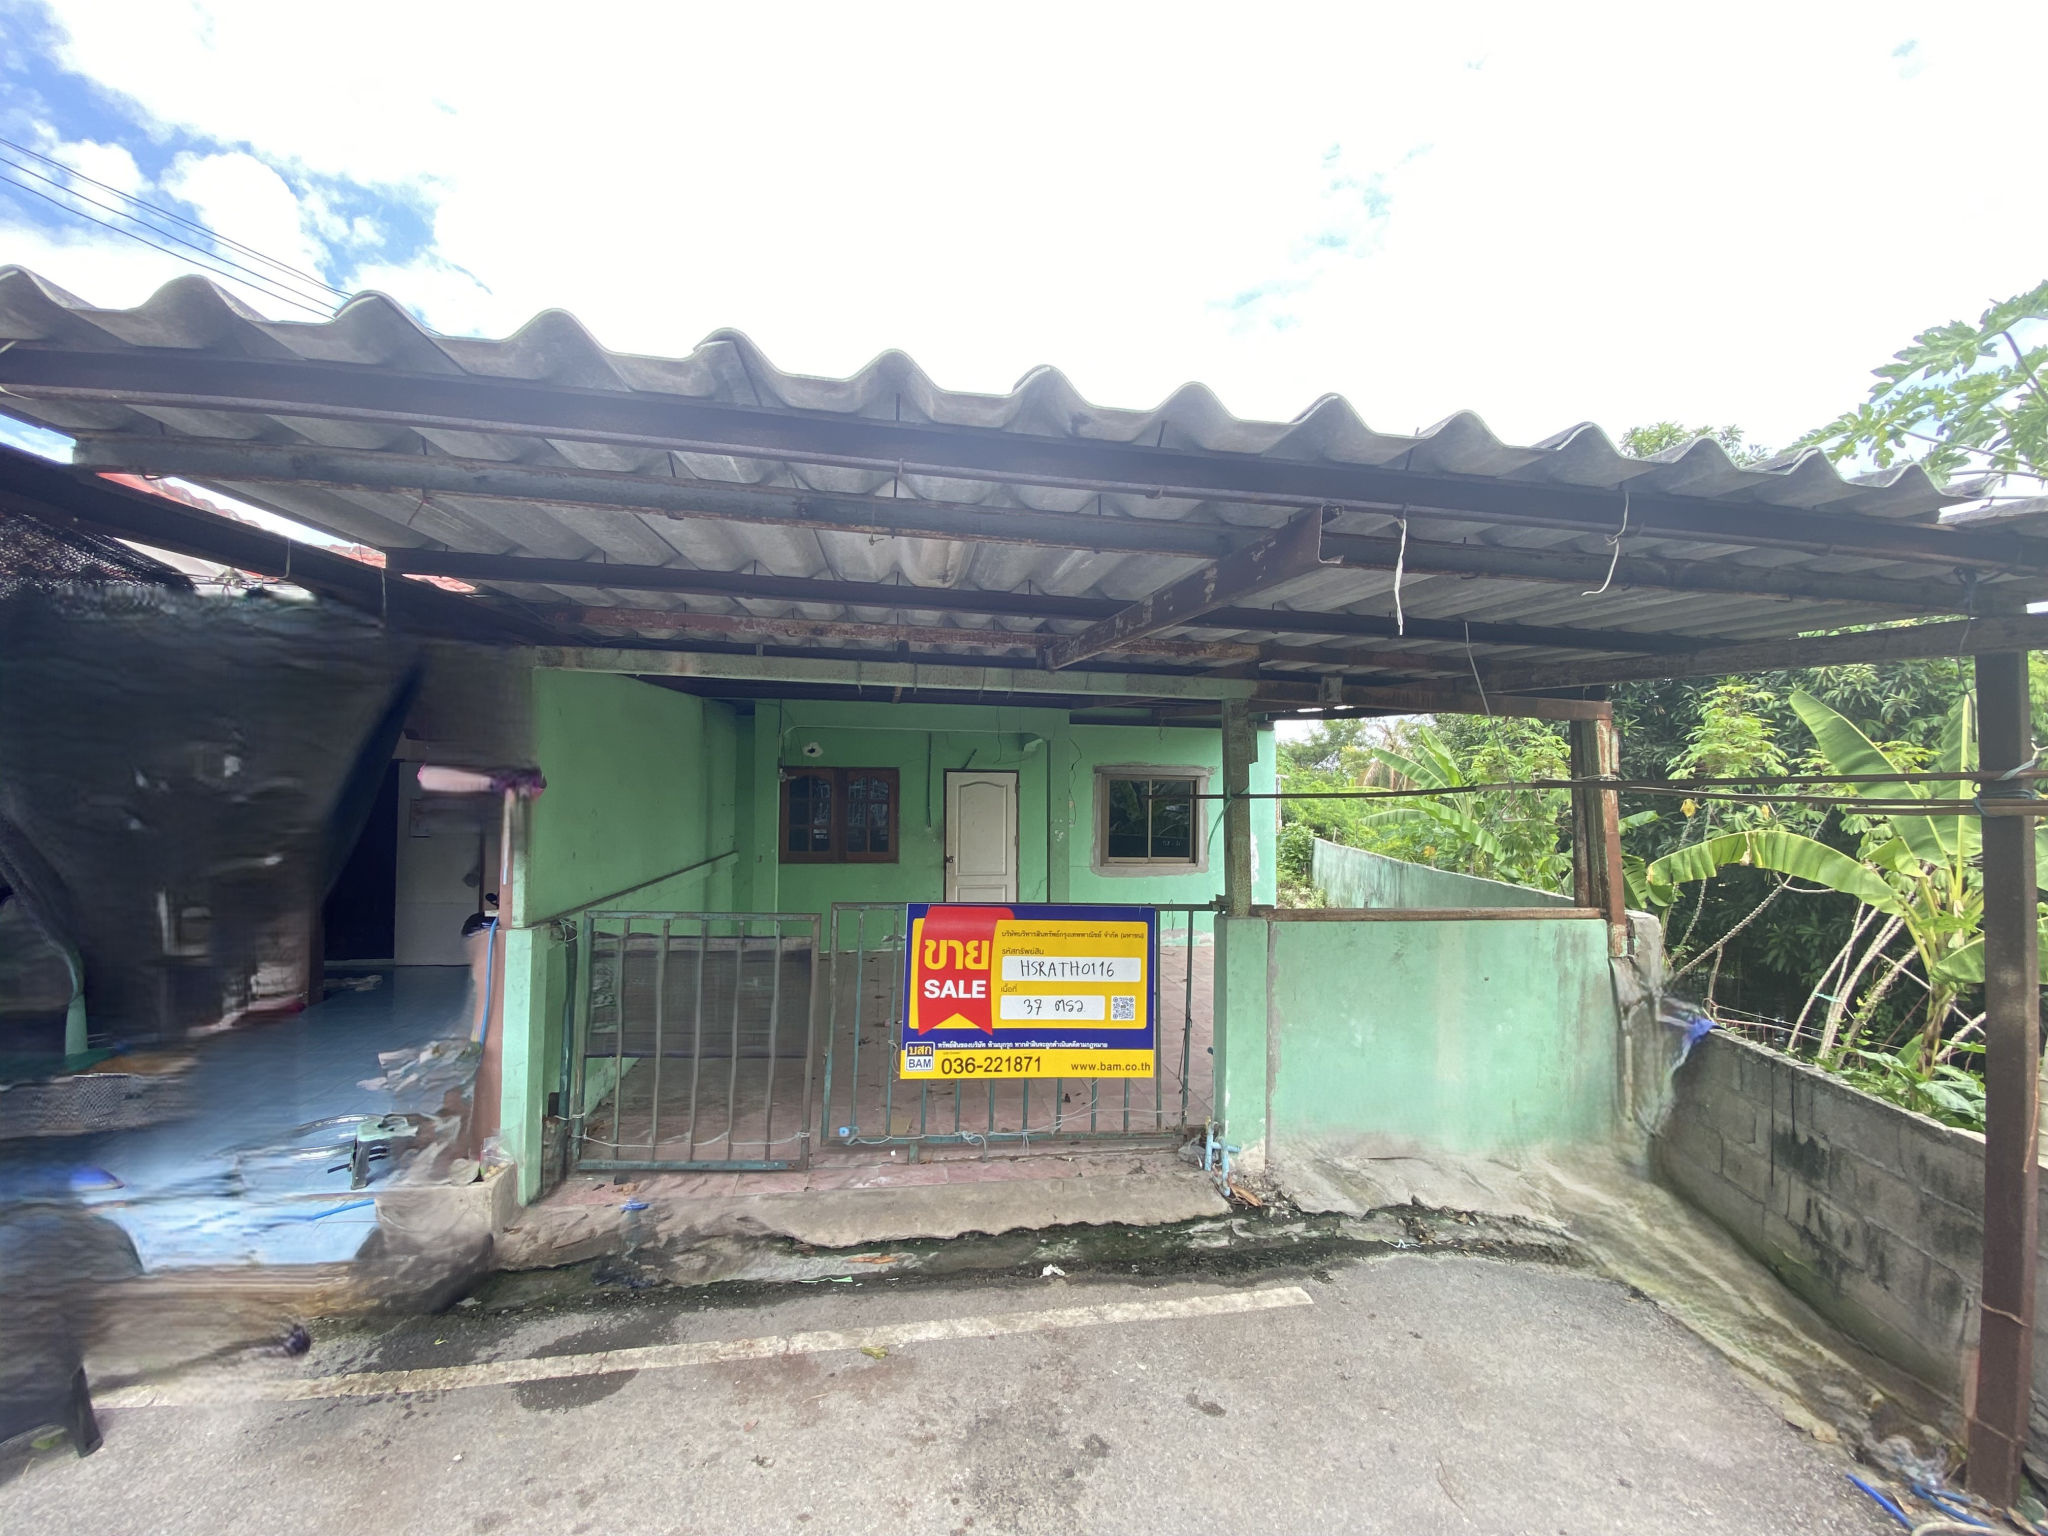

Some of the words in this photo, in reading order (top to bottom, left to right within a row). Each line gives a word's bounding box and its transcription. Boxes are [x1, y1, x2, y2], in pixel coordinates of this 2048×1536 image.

[924, 939, 988, 970] ขาย
[1001, 947, 1044, 955] รหัสทรัพย์สิน
[923, 980, 986, 999] SALE
[1000, 983, 1017, 993] เนื้อที่
[1023, 998, 1042, 1015] 37
[908, 1045, 931, 1055] บสก
[908, 1058, 932, 1069] BAM
[941, 1056, 1042, 1074] 036-221871
[1070, 1062, 1151, 1072] www.bam.co.th
